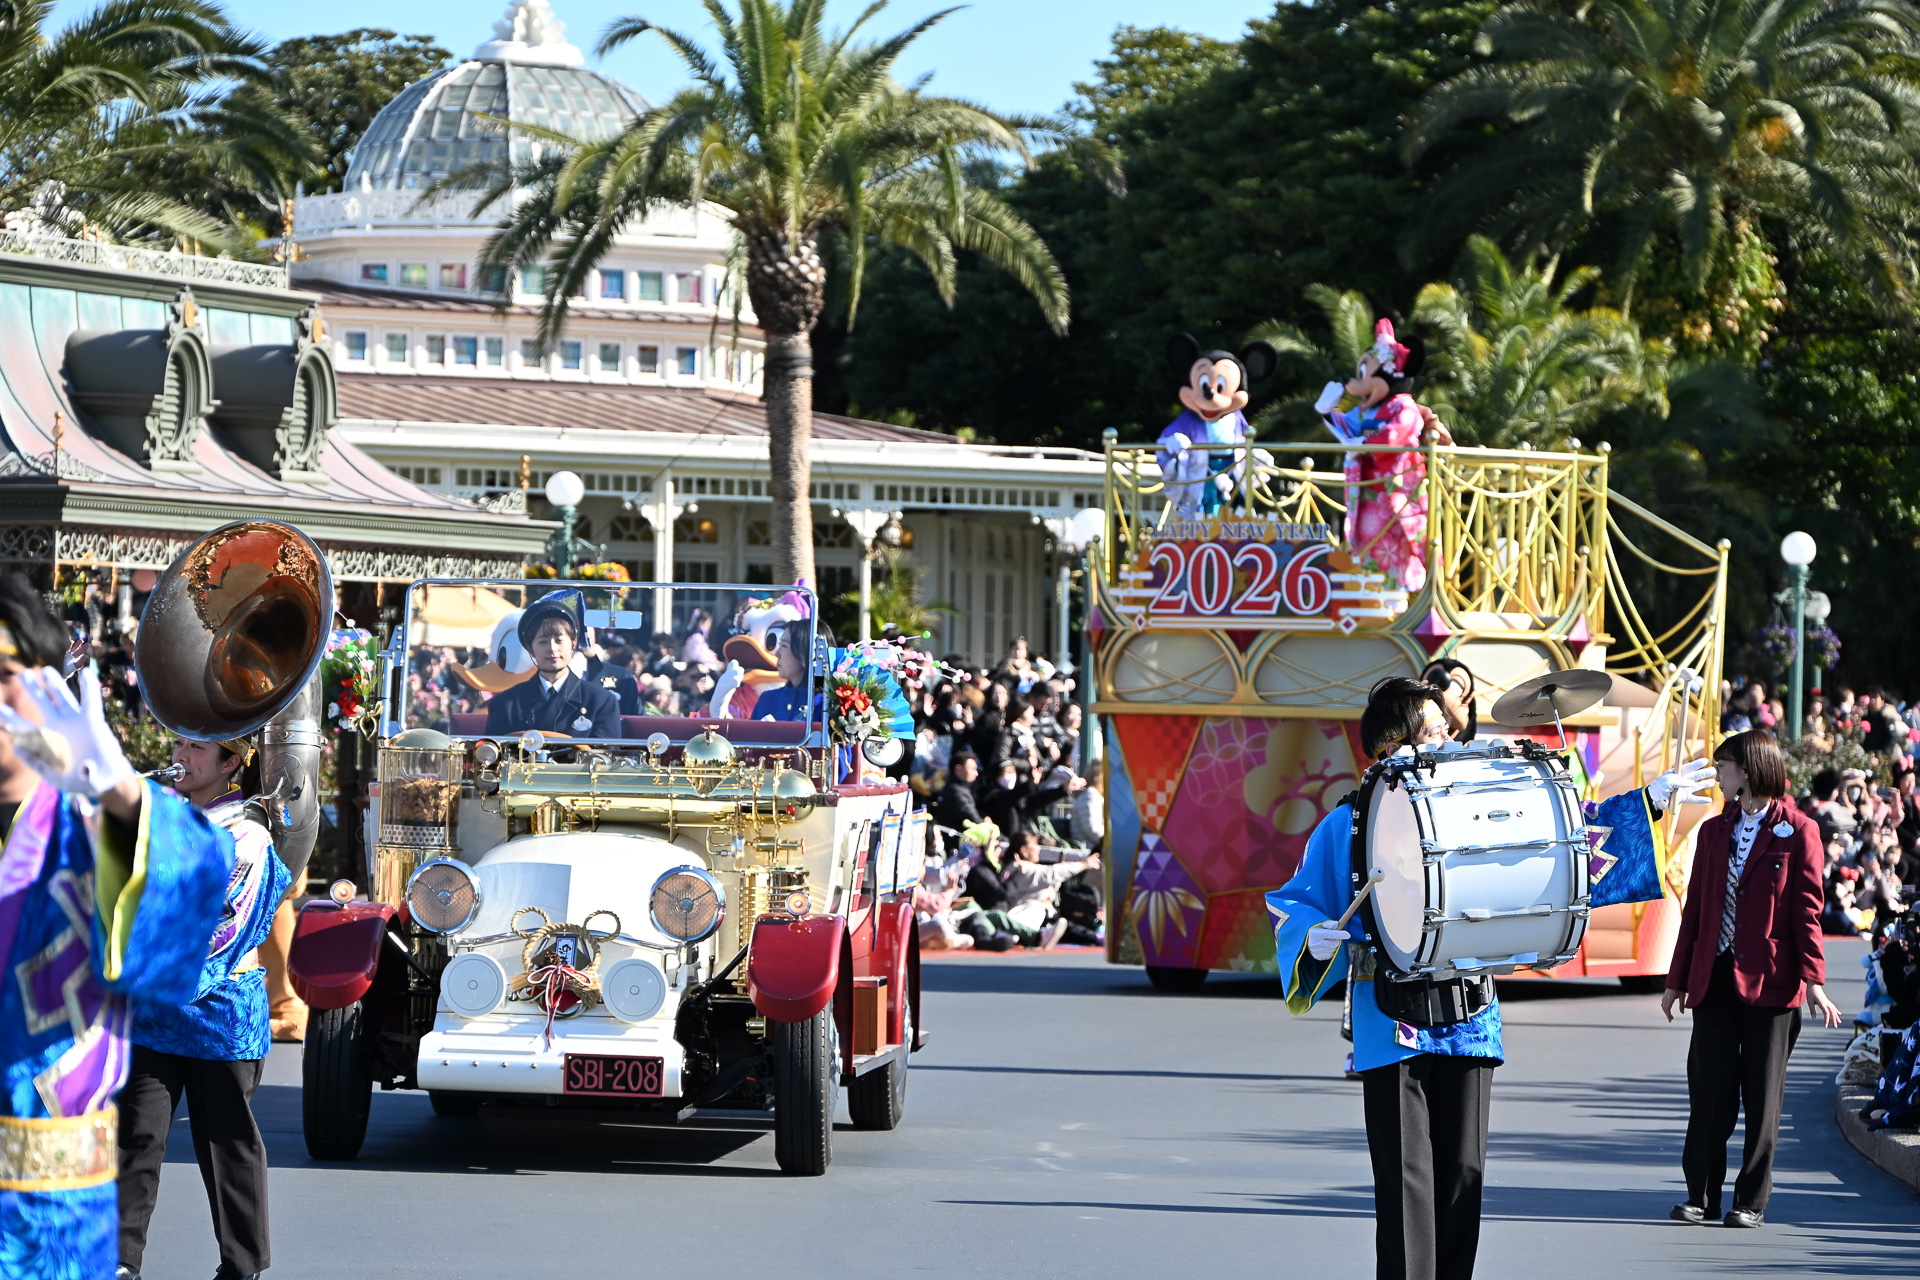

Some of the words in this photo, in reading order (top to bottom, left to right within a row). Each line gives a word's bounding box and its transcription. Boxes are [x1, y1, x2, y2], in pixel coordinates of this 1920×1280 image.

[1152, 521, 1213, 540] HAPPY
[1219, 521, 1269, 540] NEW
[1272, 521, 1332, 540] YEAR
[1149, 542, 1331, 614] 2026
[569, 1058, 658, 1092] SBI-208
